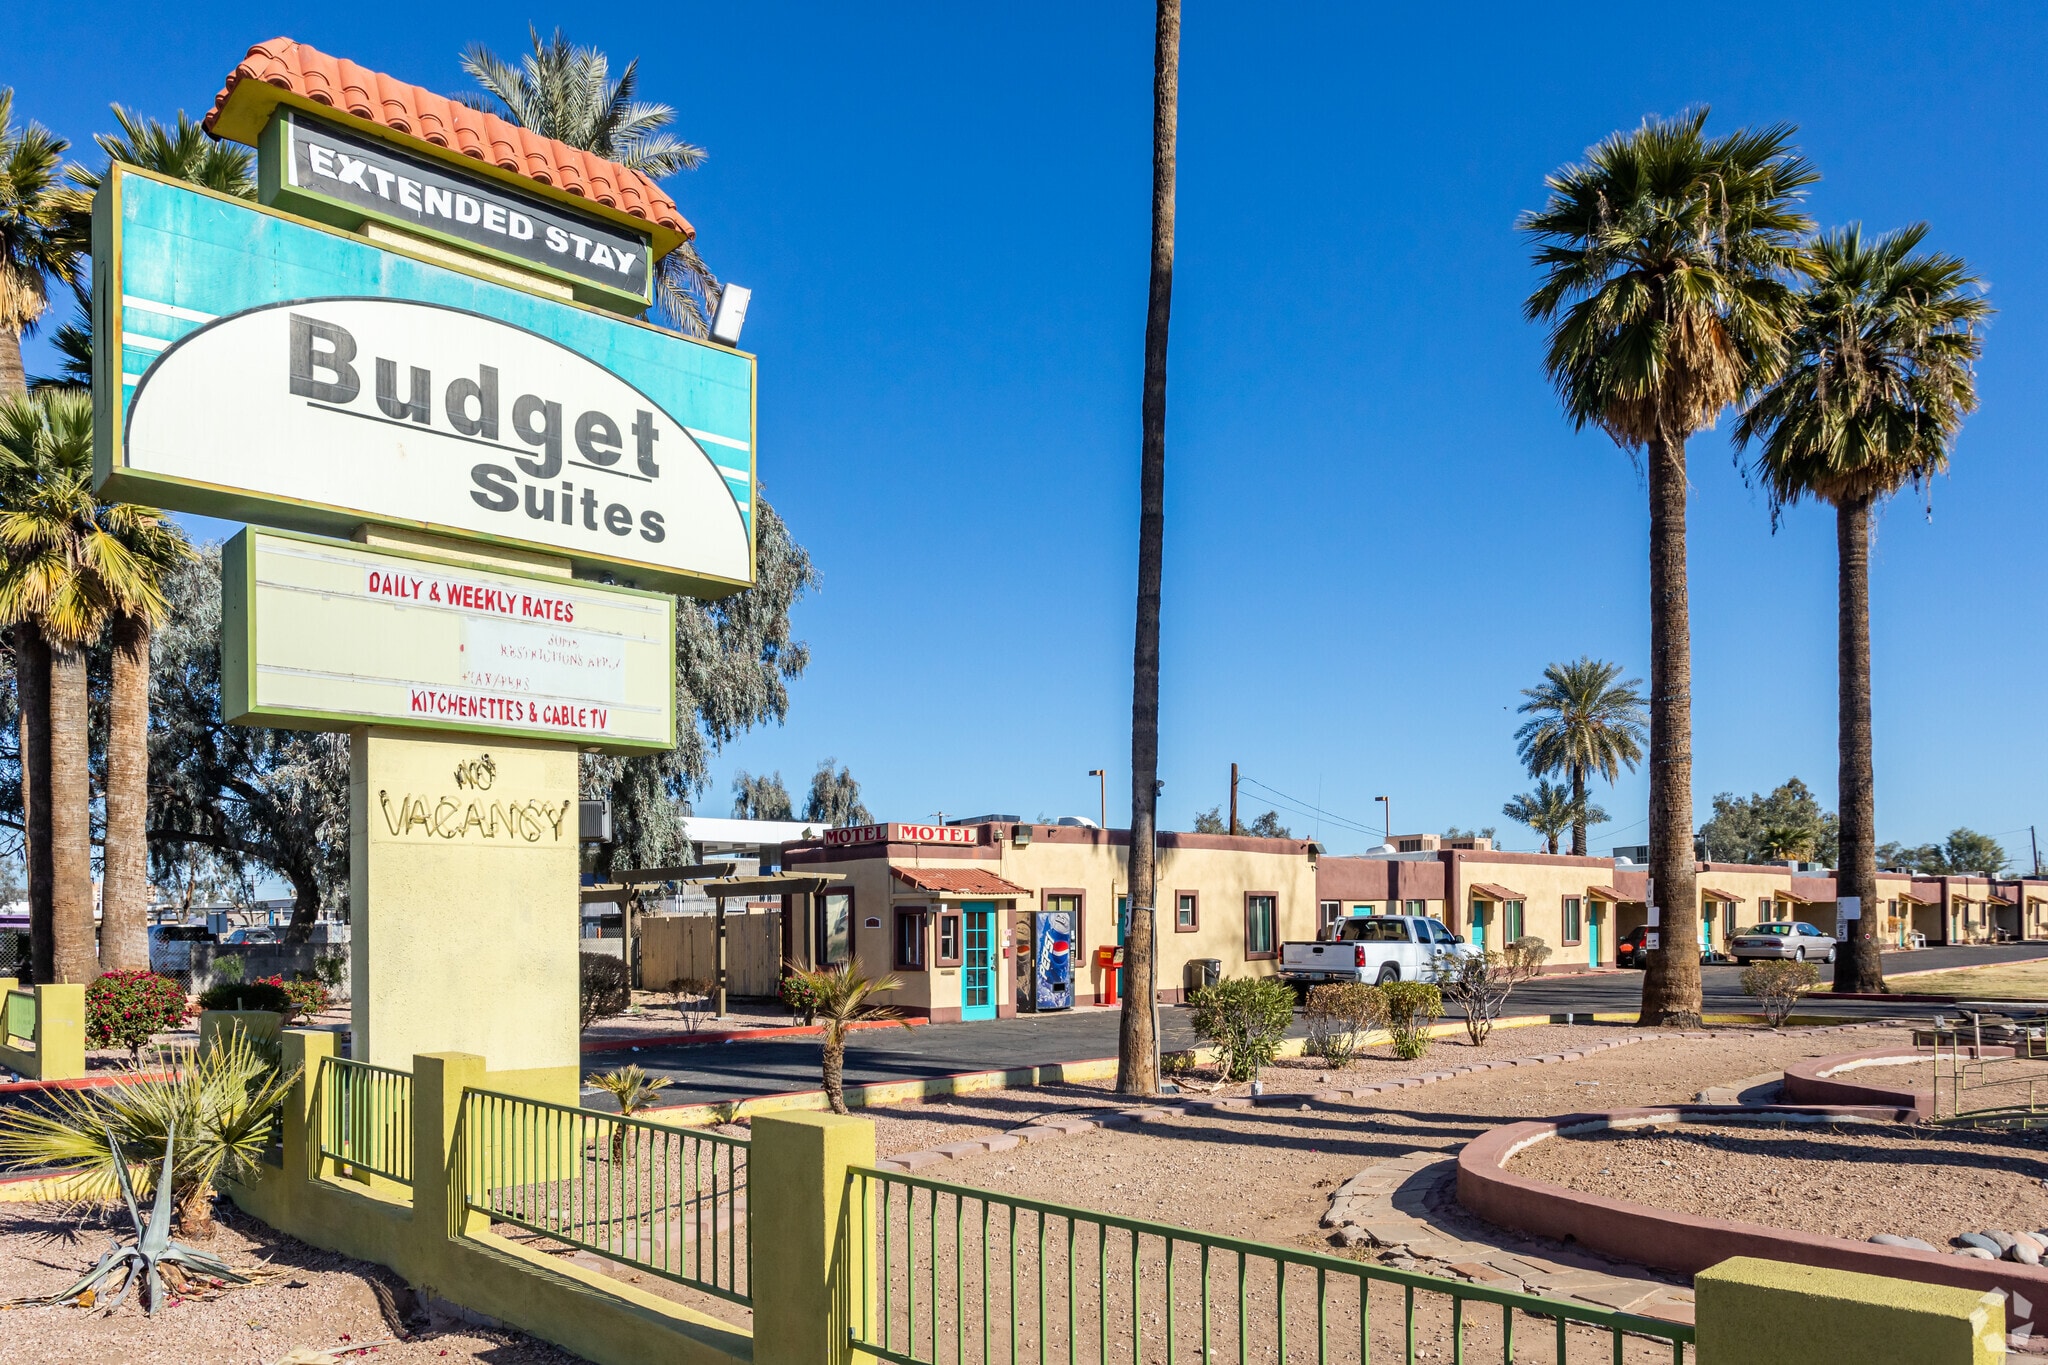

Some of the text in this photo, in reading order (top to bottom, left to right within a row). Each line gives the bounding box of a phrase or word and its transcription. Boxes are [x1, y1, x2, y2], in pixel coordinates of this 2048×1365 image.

[308, 142, 637, 275] EXTENDED STAY
[289, 312, 660, 479] Budget
[470, 463, 666, 543] Suites
[369, 571, 574, 623] DAILY & WEEKLY RATES
[411, 689, 607, 729] KITCHENETTES & CABLE TV
[453, 756, 497, 791] NO
[379, 790, 570, 842] VACANCY
[825, 825, 887, 845] MOTEL
[901, 825, 975, 843] MOTEL
[1040, 931, 1055, 980] PEPSI
